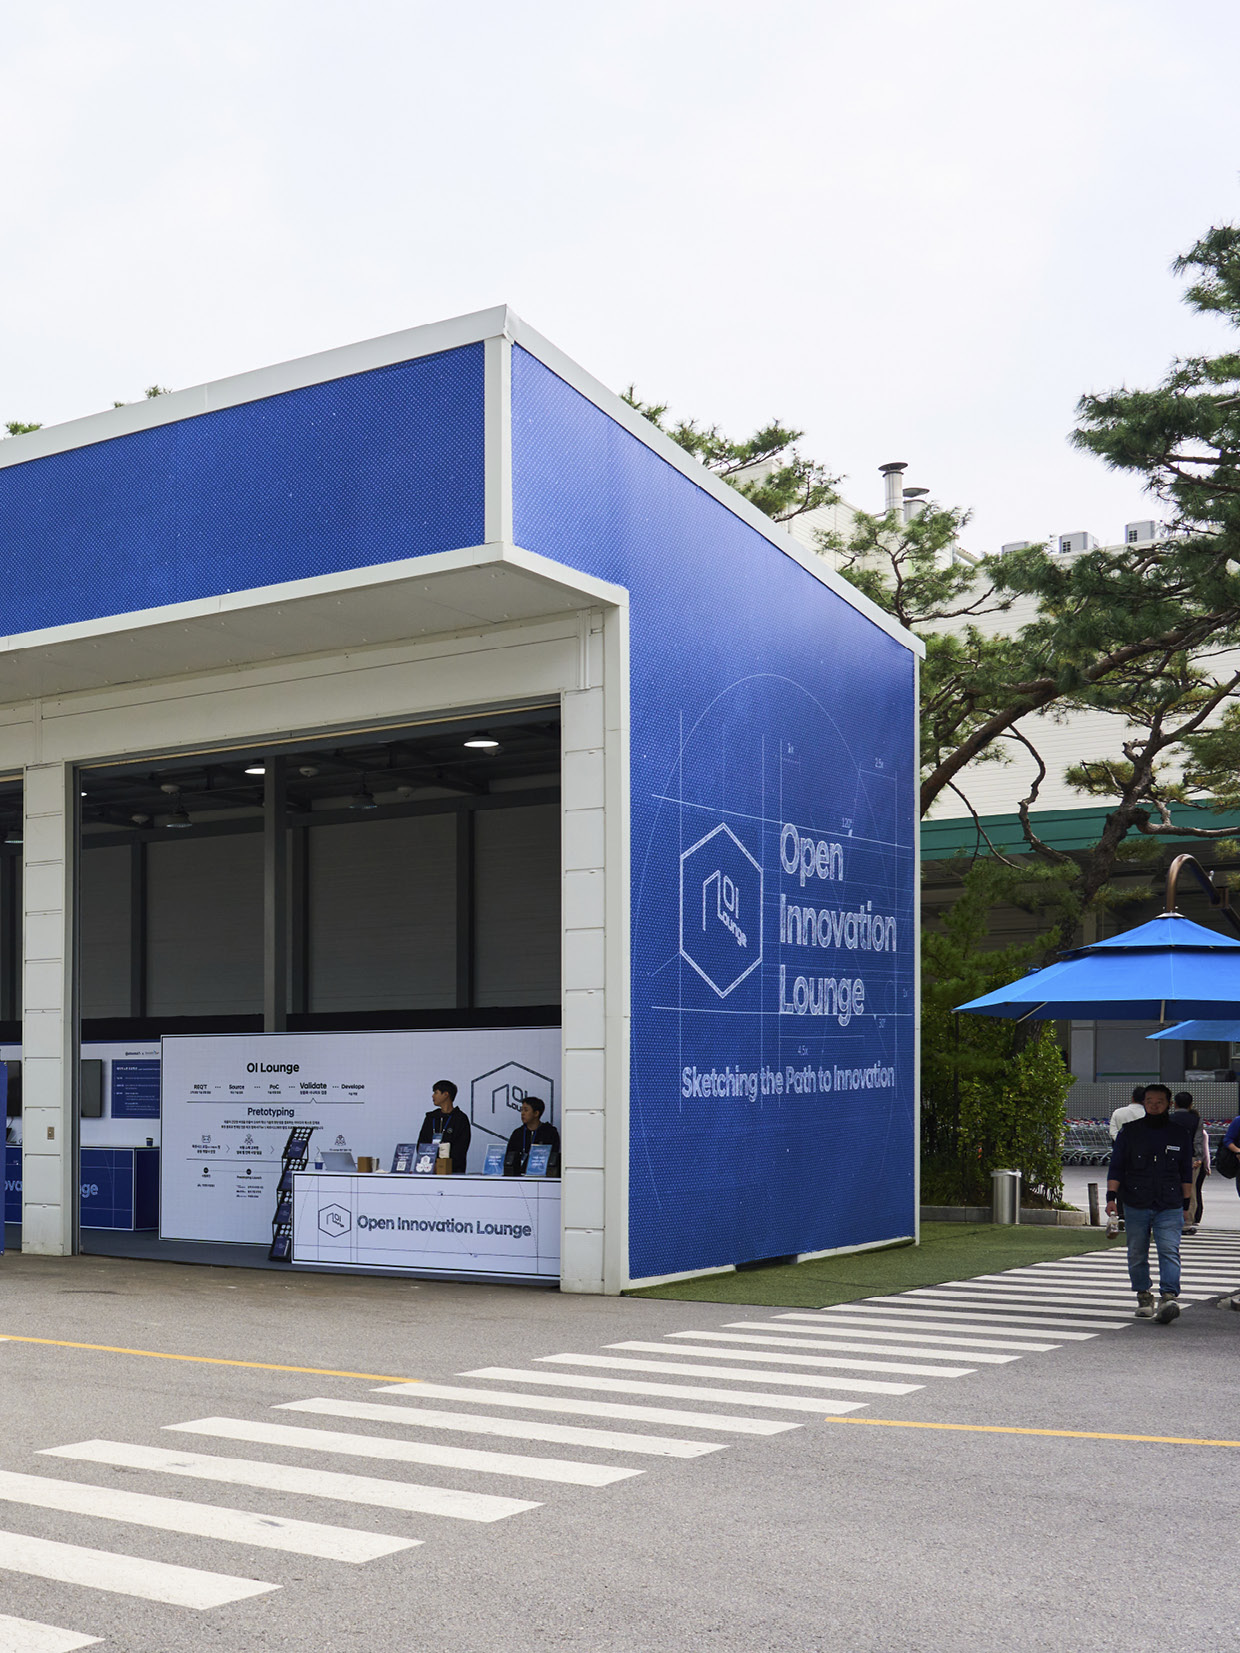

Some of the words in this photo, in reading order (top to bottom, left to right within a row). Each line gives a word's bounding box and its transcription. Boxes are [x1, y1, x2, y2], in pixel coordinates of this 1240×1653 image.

[780, 823, 844, 887] Open
[780, 893, 897, 952] Innovation
[779, 965, 865, 1027] Lounge
[246, 1062, 258, 1073] OI
[260, 1062, 300, 1075] Lounge
[681, 1065, 758, 1102] Sketching
[760, 1065, 784, 1095] the
[785, 1065, 816, 1093] Path
[817, 1066, 832, 1092] to
[833, 1060, 895, 1091] Innovation
[300, 1082, 327, 1090] Validate
[247, 1107, 295, 1118] Pretotyping
[357, 1214, 394, 1231] Open
[397, 1216, 474, 1234] Innovation
[476, 1220, 532, 1239] Lounge
